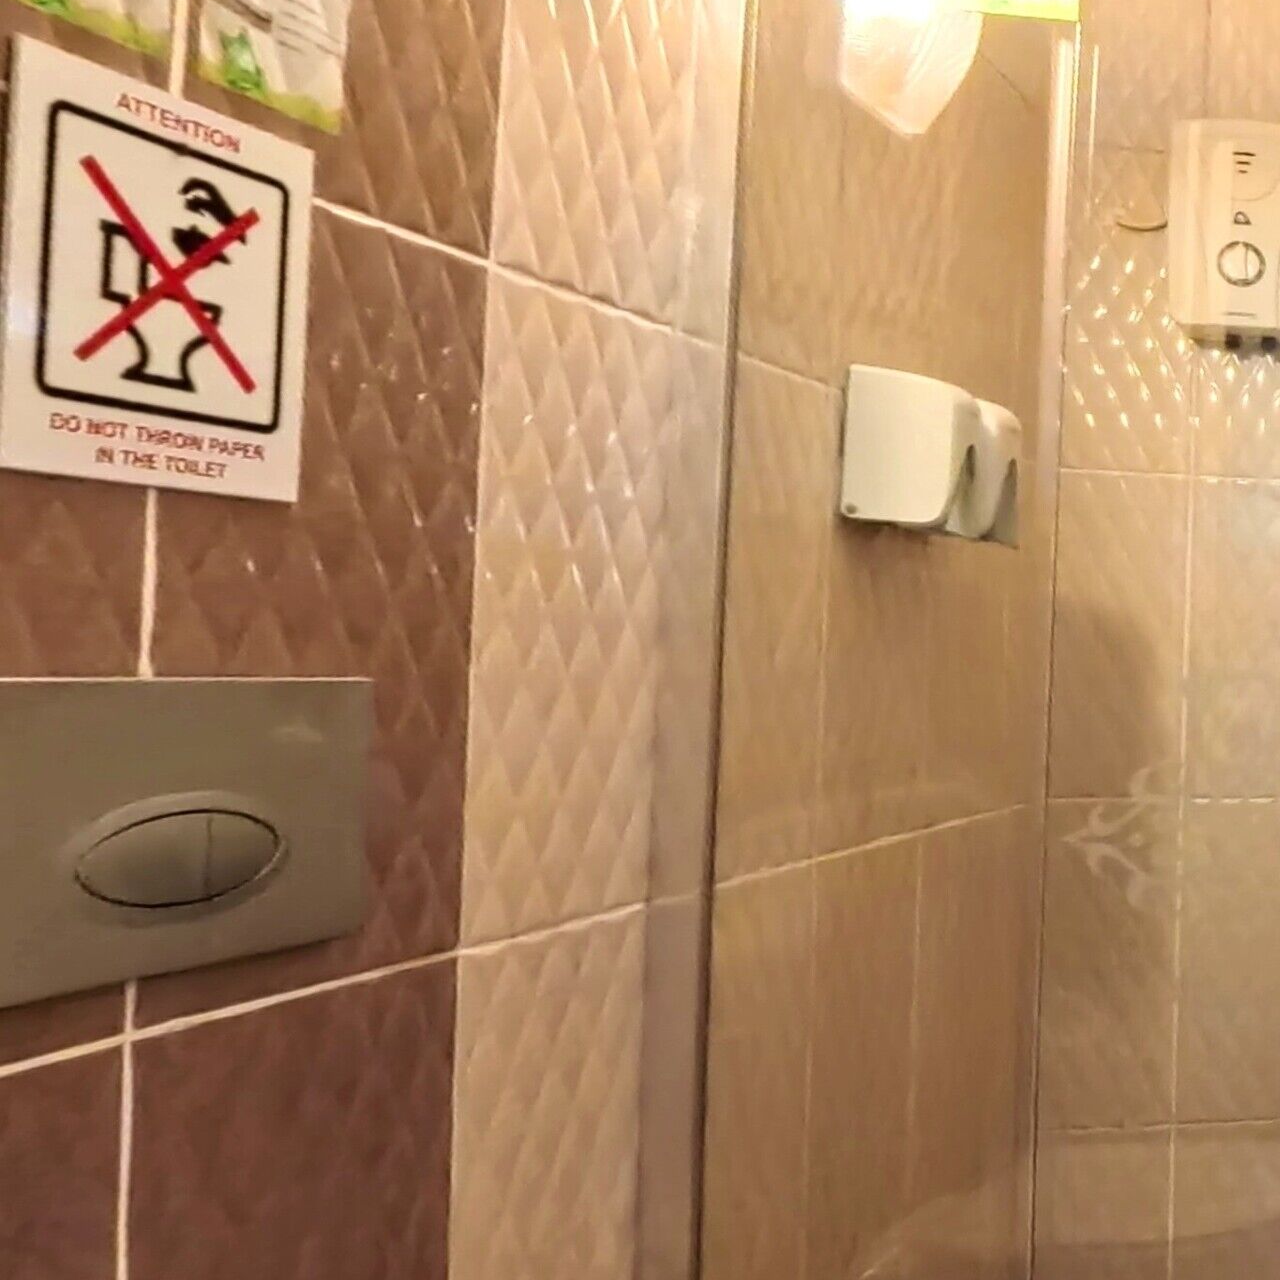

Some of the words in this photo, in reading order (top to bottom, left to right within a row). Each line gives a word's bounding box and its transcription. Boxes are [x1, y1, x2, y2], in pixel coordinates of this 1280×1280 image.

[117, 92, 240, 153] ATTENTION
[50, 413, 81, 433] DO
[85, 418, 128, 440] NOT
[135, 425, 205, 451] THROW
[207, 437, 265, 461] PAPER
[96, 446, 114, 464] IN
[120, 449, 159, 470] THE
[165, 455, 227, 478] TOILET
